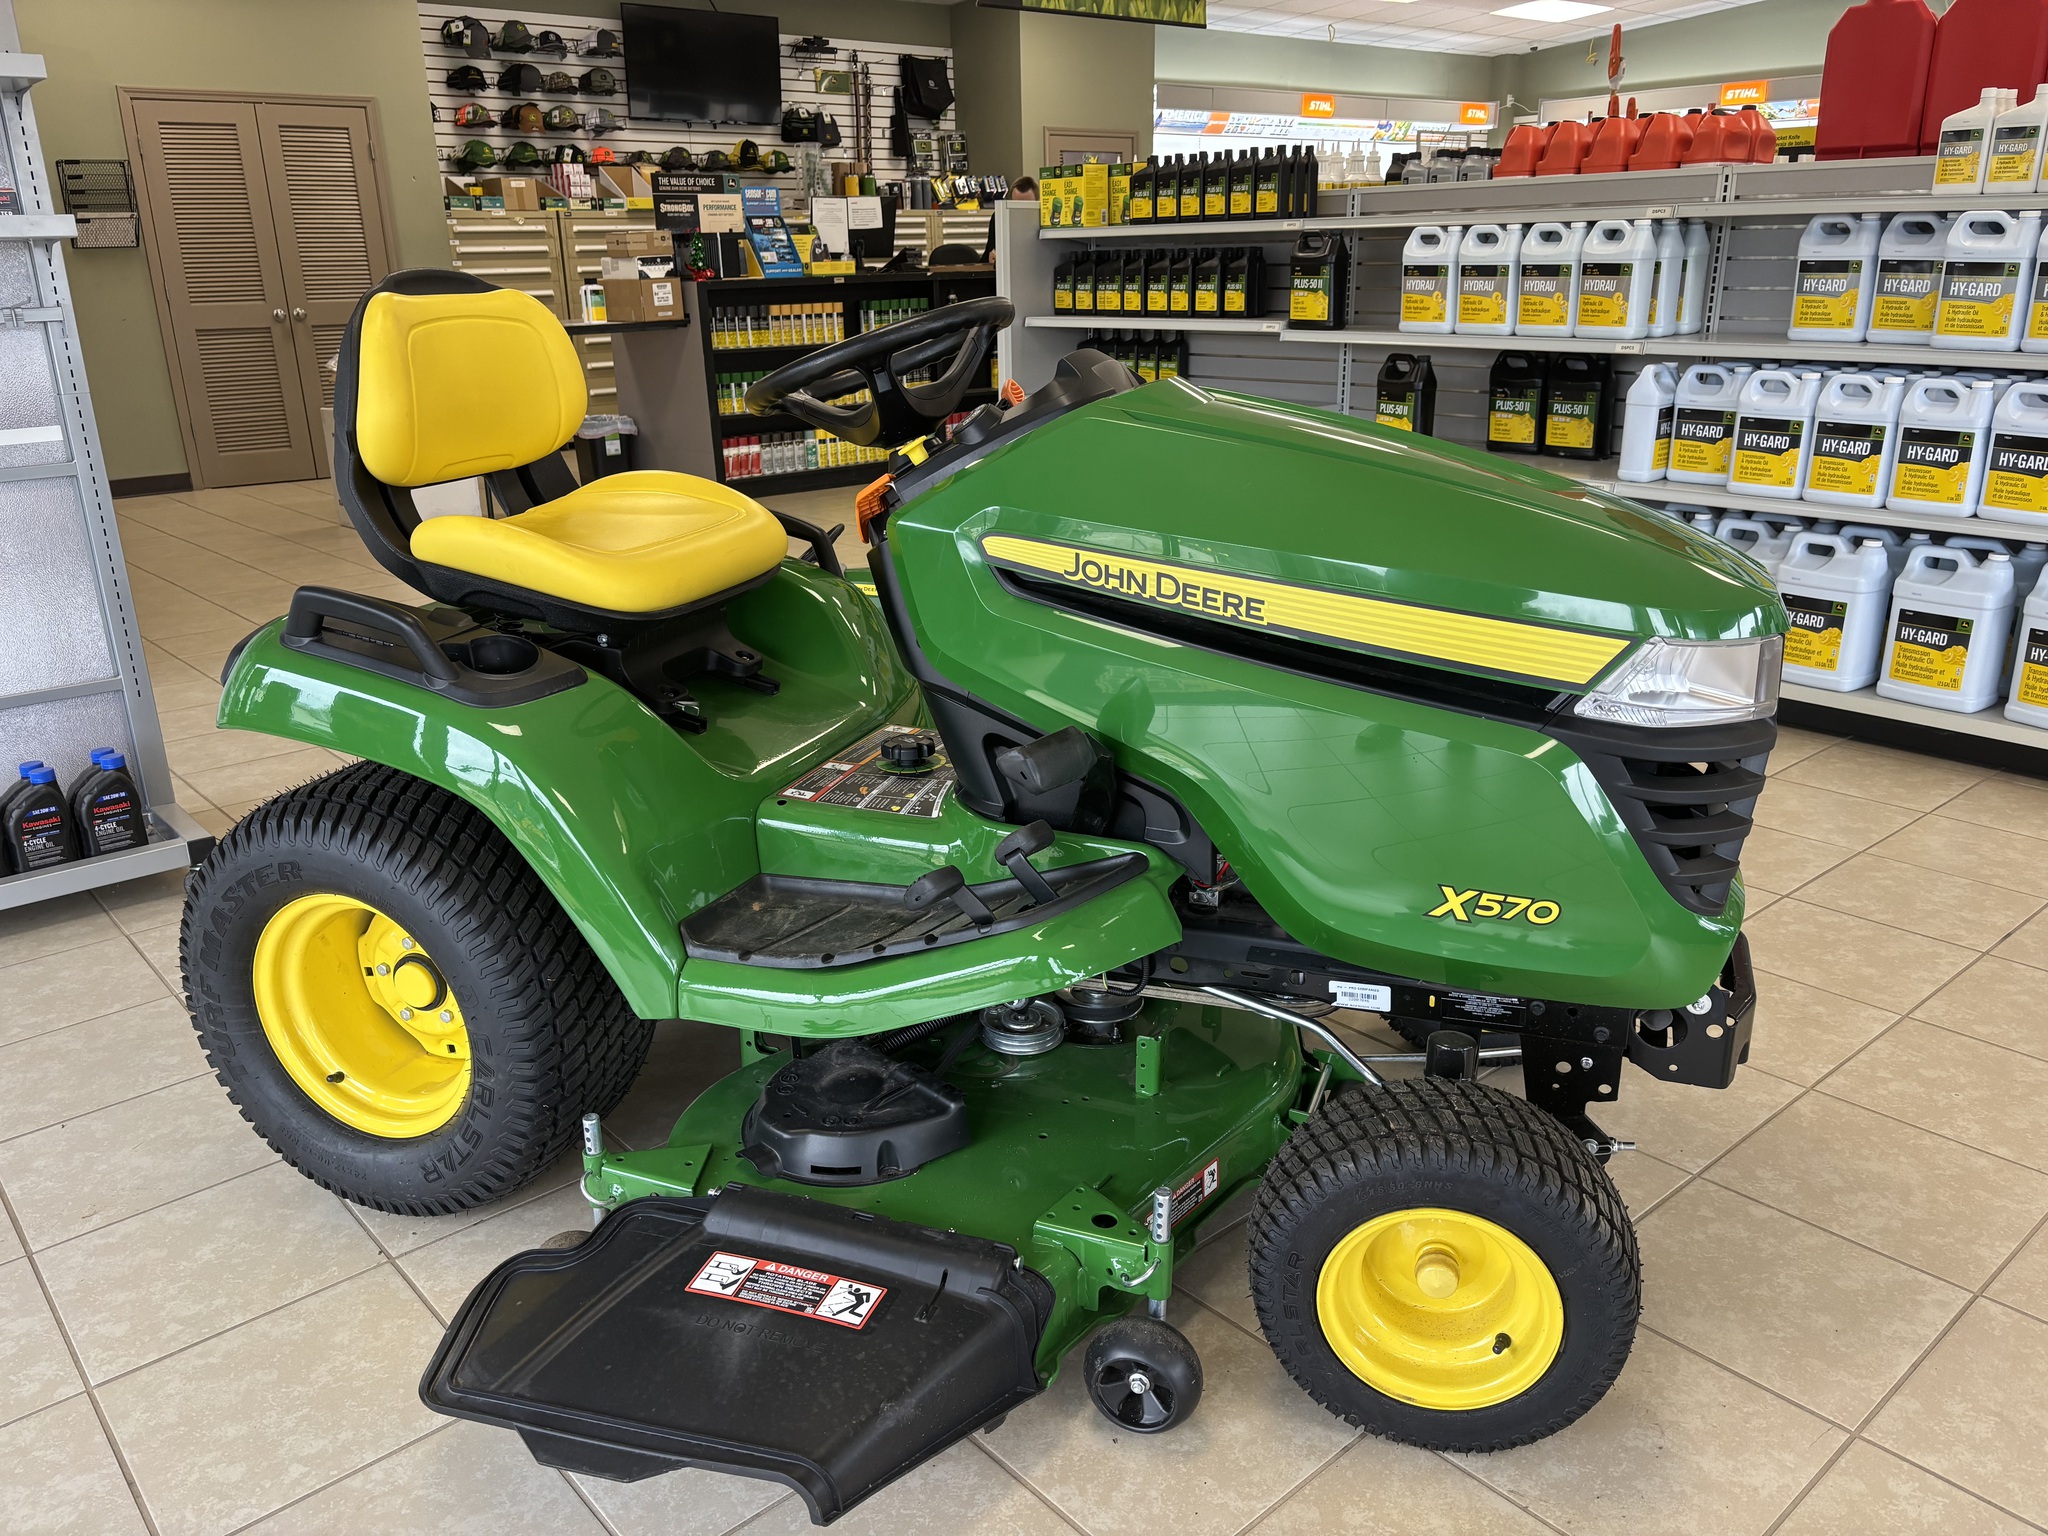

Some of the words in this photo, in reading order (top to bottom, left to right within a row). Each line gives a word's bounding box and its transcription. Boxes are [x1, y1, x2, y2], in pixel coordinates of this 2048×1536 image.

[1725, 87, 1759, 100] STIHL
[1309, 100, 1332, 112] STIHL
[1466, 108, 1486, 119] STIHL
[1944, 145, 1973, 155] HY-GARD
[1998, 142, 2028, 153] HY-GARD
[658, 177, 669, 185] THE
[670, 177, 687, 185] VALUE
[688, 178, 694, 186] OF
[695, 178, 715, 186] CHOICE
[1112, 186, 1127, 194] CHANGE
[1294, 279, 1317, 289] PLUS-50
[1406, 280, 1435, 291] HYDRAU
[1463, 280, 1494, 291] HYDRAU
[1523, 280, 1556, 292] HYDRAU
[1584, 279, 1617, 292] HYDRAU
[1803, 279, 1847, 292] HY-GARD
[1884, 279, 1931, 293] HY-GARD
[1949, 282, 2002, 297] HY-GARD
[1380, 403, 1402, 415] PLUS-50
[1403, 405, 1408, 415] II
[1496, 400, 1524, 412] PLUS-50
[1525, 402, 1530, 412] II
[1553, 403, 1582, 415] PLUS-50
[1583, 405, 1589, 416] II
[1681, 423, 1724, 439] HY-GARD
[1744, 433, 1790, 449] HY-GARD
[1822, 438, 1871, 456] HY-GARD
[1907, 445, 1959, 463] HY-GARD
[1827, 472, 1851, 480] hydraulique
[1905, 466, 1932, 474] Transmission
[1913, 480, 1938, 488] hydraulique
[1996, 474, 2025, 482] Transmission
[2000, 480, 2020, 489] Hydraulic
[2004, 488, 2031, 497] hydraulique
[2004, 494, 2033, 503] transmission
[1063, 552, 1148, 595] JOHN
[1156, 571, 1265, 622] DEERE
[1786, 637, 1804, 645] ydraulic
[1900, 626, 1948, 646] HY-GARD
[1789, 644, 1816, 655] hydraulique
[1899, 644, 1931, 657] Transmission
[1902, 652, 1926, 664] Hydraulic
[1926, 656, 1934, 665] Oil
[1894, 666, 1900, 674] de
[1900, 668, 1934, 680] transmission
[1895, 660, 1908, 669] Huile
[1908, 662, 1938, 675] hydraulique
[32, 808, 40, 816] SAE
[93, 801, 131, 813] Kawasaki
[103, 808, 123, 816] ENGINES
[22, 816, 61, 829] Kawasaki
[94, 821, 117, 832] 4-CYCLE
[95, 828, 115, 837] ENGINE
[23, 836, 47, 847] 4-CYCLE
[24, 842, 44, 853] ENGINE
[1424, 884, 1562, 925] X570
[200, 859, 303, 973] MASTER
[199, 972, 248, 1084] TURF
[420, 1031, 495, 1185] CARLSTAR
[765, 1272, 796, 1281] ROTATING
[796, 1277, 818, 1287] BLADE
[778, 1264, 830, 1283] DANGER
[695, 1314, 720, 1328] DO
[721, 1320, 757, 1336] NOT
[757, 1329, 828, 1351] REMOVE
